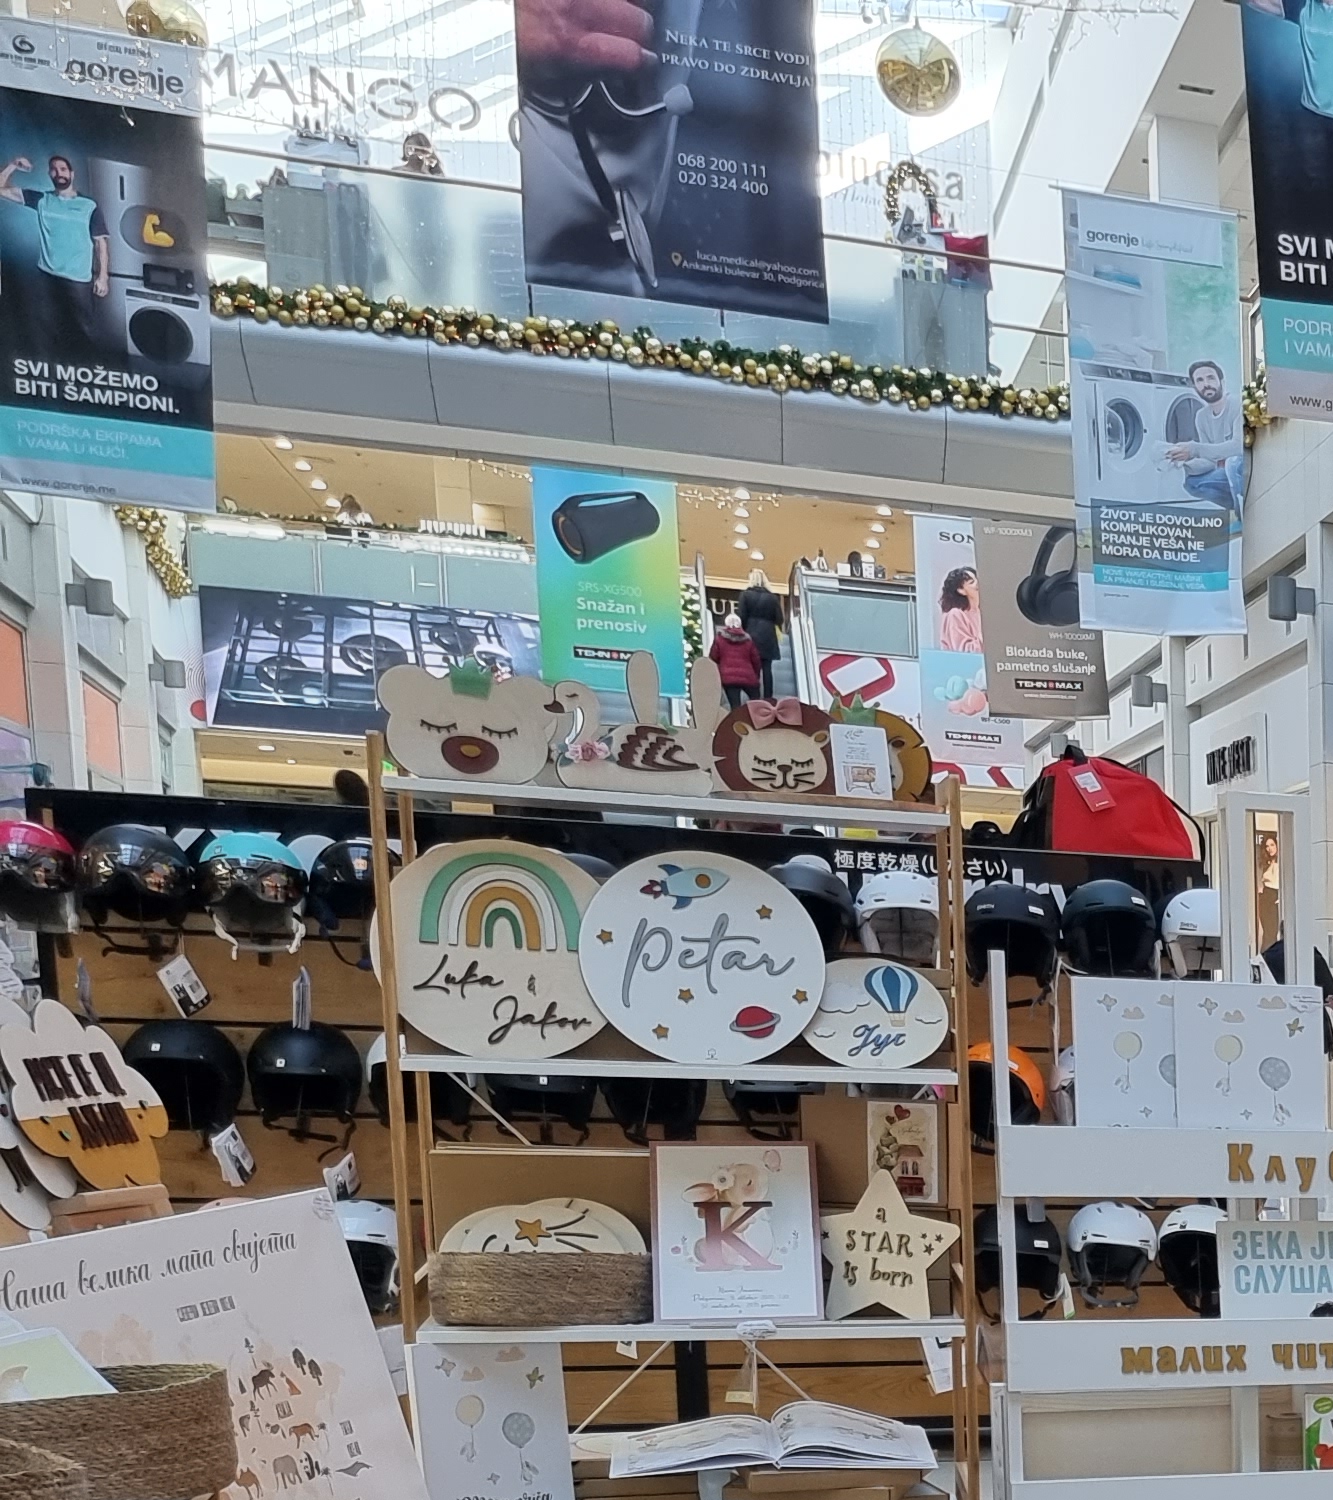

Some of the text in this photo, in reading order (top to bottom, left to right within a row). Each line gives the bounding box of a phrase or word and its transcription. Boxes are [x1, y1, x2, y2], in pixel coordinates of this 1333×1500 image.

[665, 29, 811, 66] NEKA TE SRCE VODI
[64, 58, 185, 97] gorenje
[661, 53, 811, 87] PRAVO DO ZDRAVLJA
[198, 53, 482, 132] MANGO
[677, 152, 767, 179] 068 200 111
[678, 170, 769, 197] 020 324 400
[1086, 229, 1139, 248] gorenje
[1277, 233, 1318, 258] SVI
[681, 259, 825, 290] Ankarski bulevar 30, Podgorica
[696, 250, 819, 278] luca.medical@yahoo.com
[1279, 260, 1327, 286] BITI
[14, 358, 159, 392] SVI MOŽEMO
[15, 377, 180, 414] BITI ŠAMPIONI.
[16, 420, 162, 449] PODRŠKA EKIPAMA
[26, 435, 70, 453] VAMA
[74, 442, 85, 456] U
[88, 445, 130, 461] KUĆI.
[20, 475, 117, 497] www.gorenje.me
[1100, 505, 1223, 529] ŽIVOT JE DOVOLJNO
[1100, 519, 1195, 540] KOMPLIKOVAN.
[1101, 533, 1205, 552] PRANJE VEŠA NE
[1101, 544, 1201, 563] MORA DA BUDE.
[577, 581, 642, 597] SRS-XG500
[577, 596, 645, 616] Snažan i
[577, 617, 647, 634] prenosiv
[1005, 646, 1088, 661] Blokada buke,
[996, 661, 1096, 676] pametno slušanje
[620, 913, 797, 1008] Petar
[413, 953, 538, 998] Luka &
[488, 996, 592, 1045] Jakov
[875, 1207, 886, 1223] a
[693, 1200, 783, 1272] K
[845, 1229, 914, 1258] STAR
[1232, 1230, 1302, 1261] ЗЕКА
[78, 1259, 152, 1297] велика
[843, 1257, 914, 1288] is born
[1120, 1345, 1248, 1376] малих
